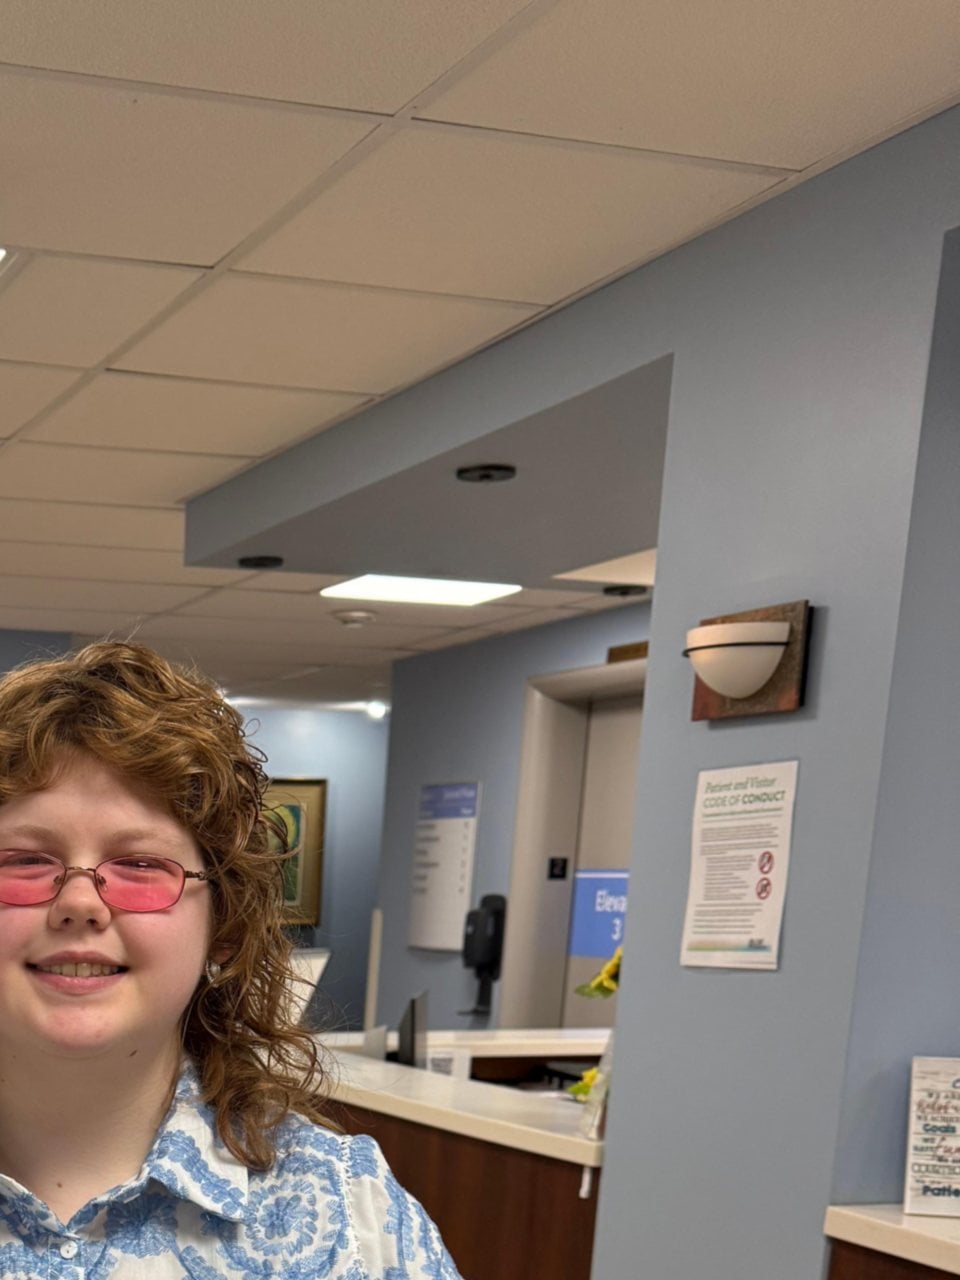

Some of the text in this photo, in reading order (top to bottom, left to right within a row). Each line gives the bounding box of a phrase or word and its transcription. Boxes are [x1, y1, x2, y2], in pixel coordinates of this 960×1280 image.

[704, 777, 777, 794] Patient and Visitor
[703, 790, 786, 809] CODE OF CONDUCT
[611, 917, 622, 941] 3
[923, 1123, 956, 1133] Goals
